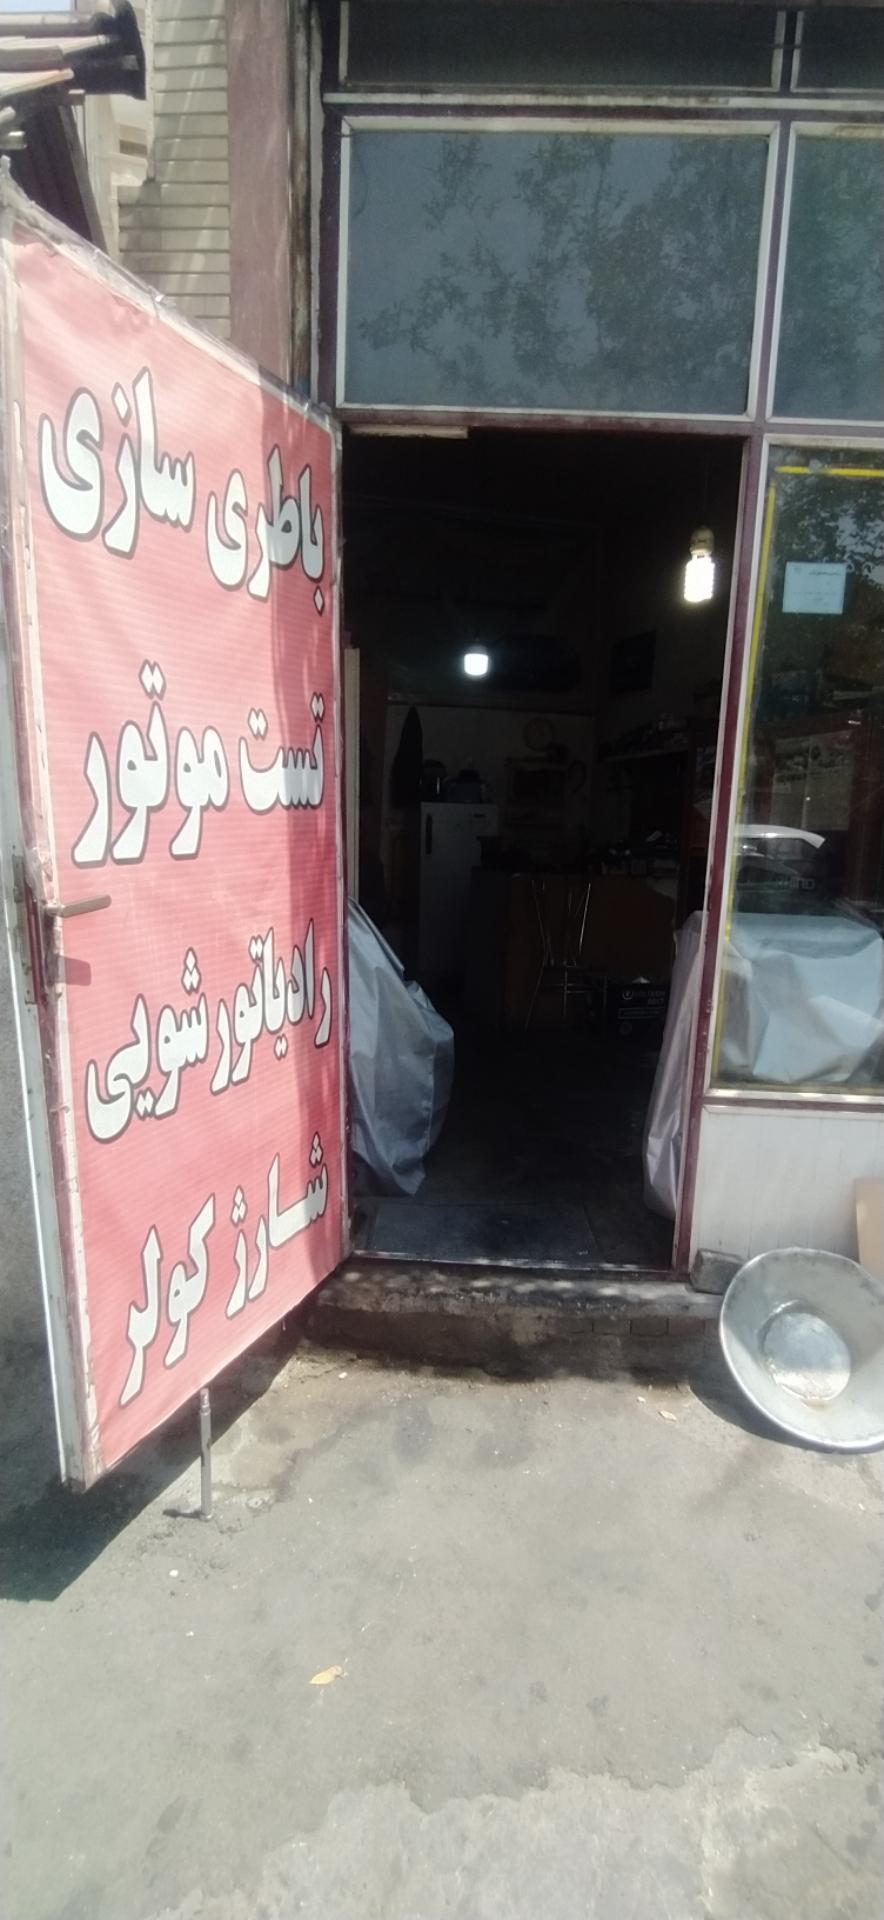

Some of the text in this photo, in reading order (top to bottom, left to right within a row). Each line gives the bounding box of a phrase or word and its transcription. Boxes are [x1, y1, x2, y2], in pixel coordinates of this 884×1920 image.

[39, 366, 325, 615] باطری سازی
[71, 659, 325, 867] تست موتور
[119, 1131, 329, 1408] شارژ کولر
